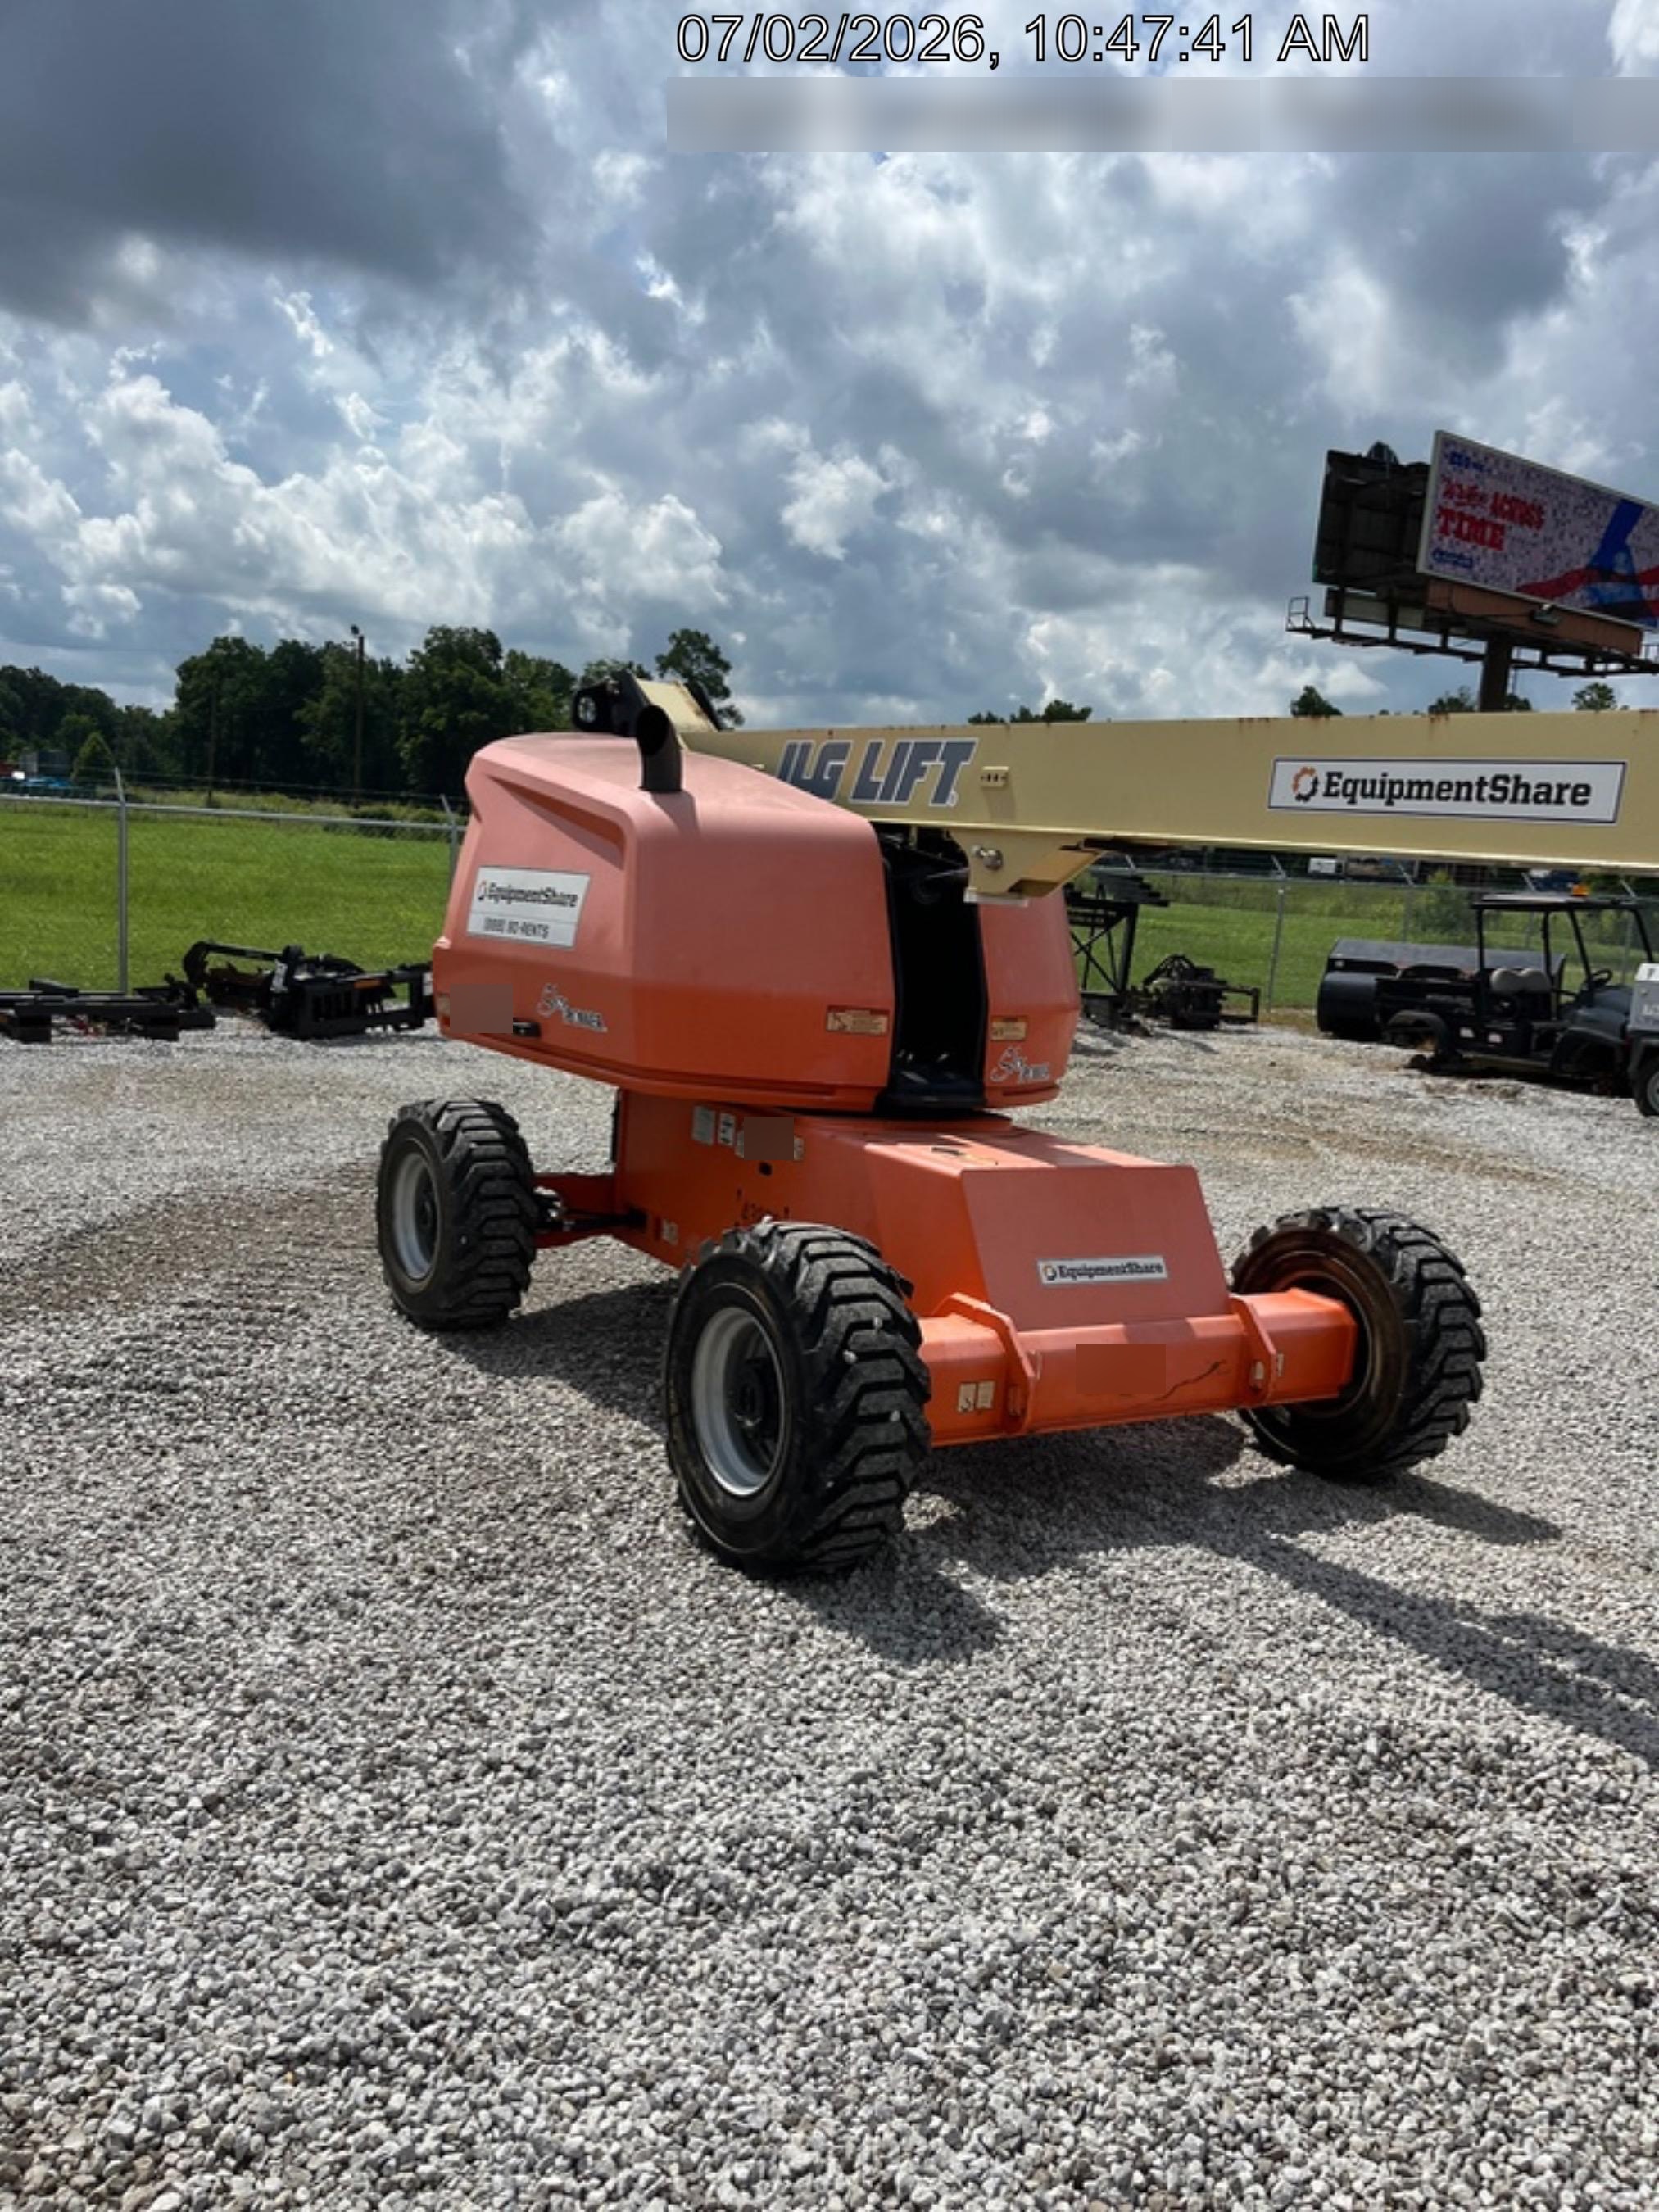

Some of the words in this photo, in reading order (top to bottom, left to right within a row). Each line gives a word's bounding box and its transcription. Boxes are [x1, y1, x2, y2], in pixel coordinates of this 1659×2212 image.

[849, 737, 978, 806] LIFT
[1321, 771, 1591, 806] EquipmentShare
[488, 882, 578, 909] EquipmentShare
[1057, 1262, 1163, 1281] EquipmentShare
